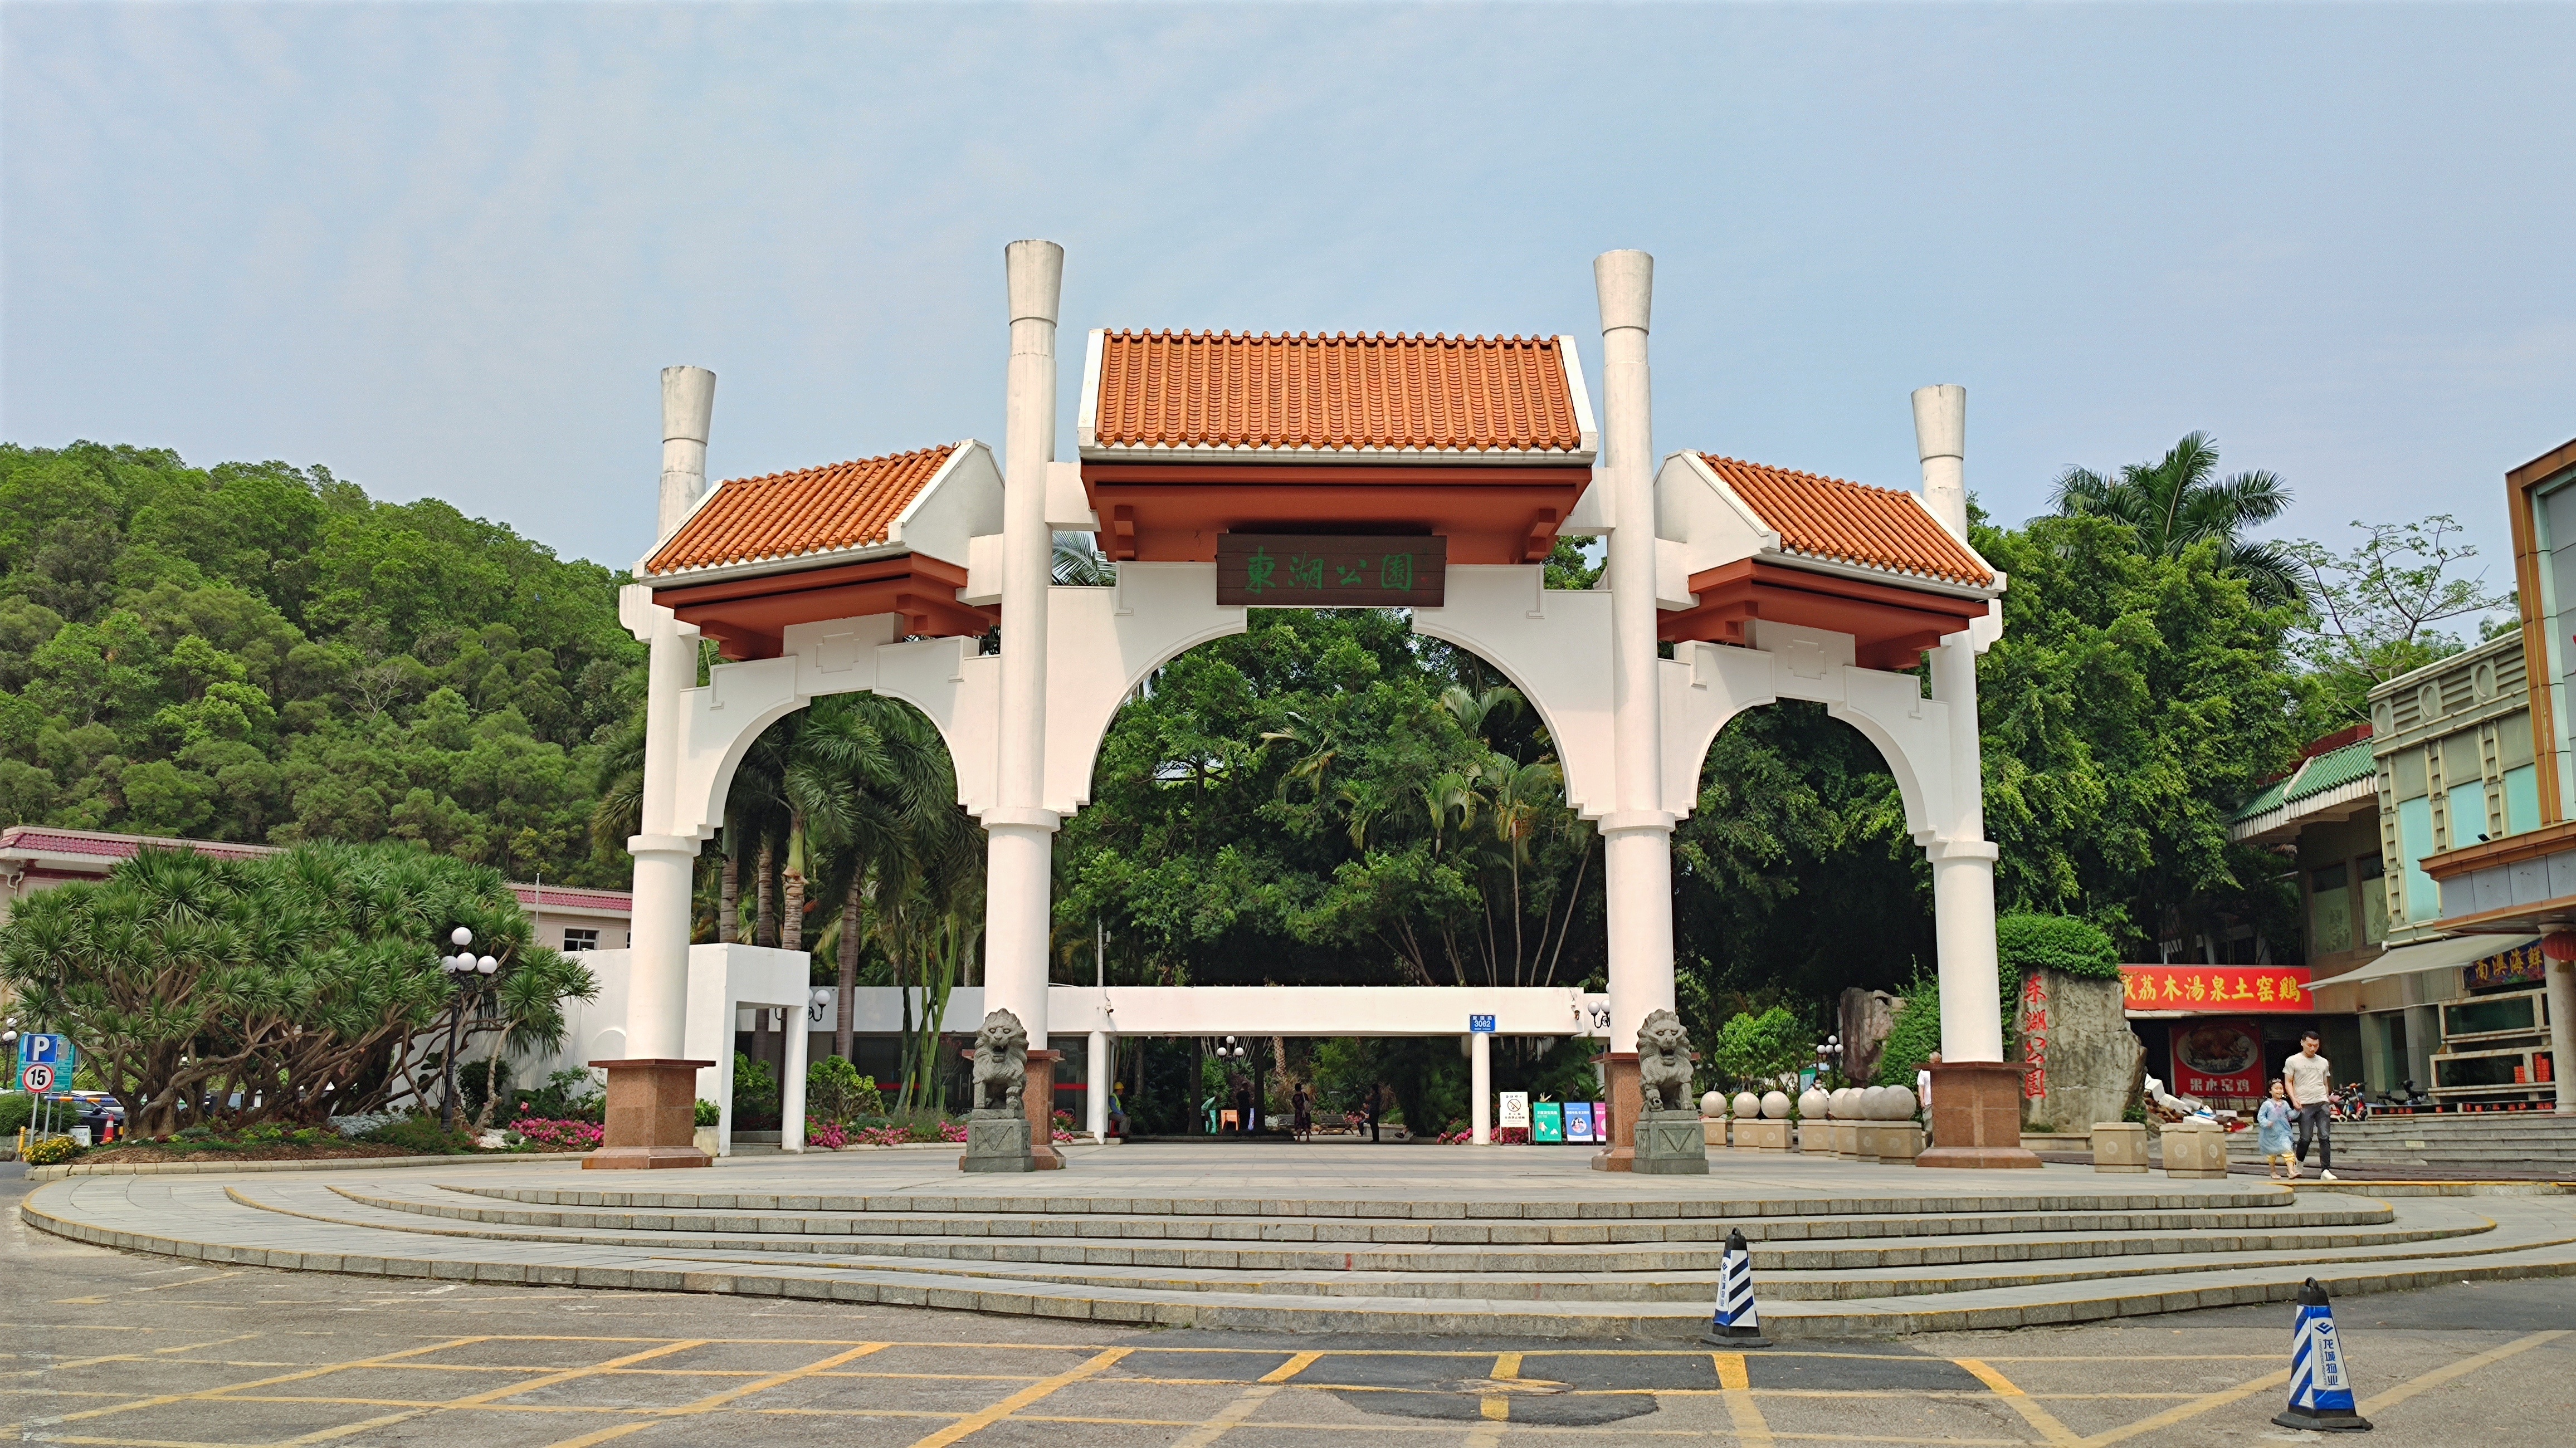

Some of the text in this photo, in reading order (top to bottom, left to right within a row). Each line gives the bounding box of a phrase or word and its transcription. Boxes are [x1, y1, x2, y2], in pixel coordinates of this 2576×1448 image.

[32, 1036, 50, 1061] P
[31, 1069, 46, 1085] 15
[2323, 1338, 2339, 1386] 龙城物业
